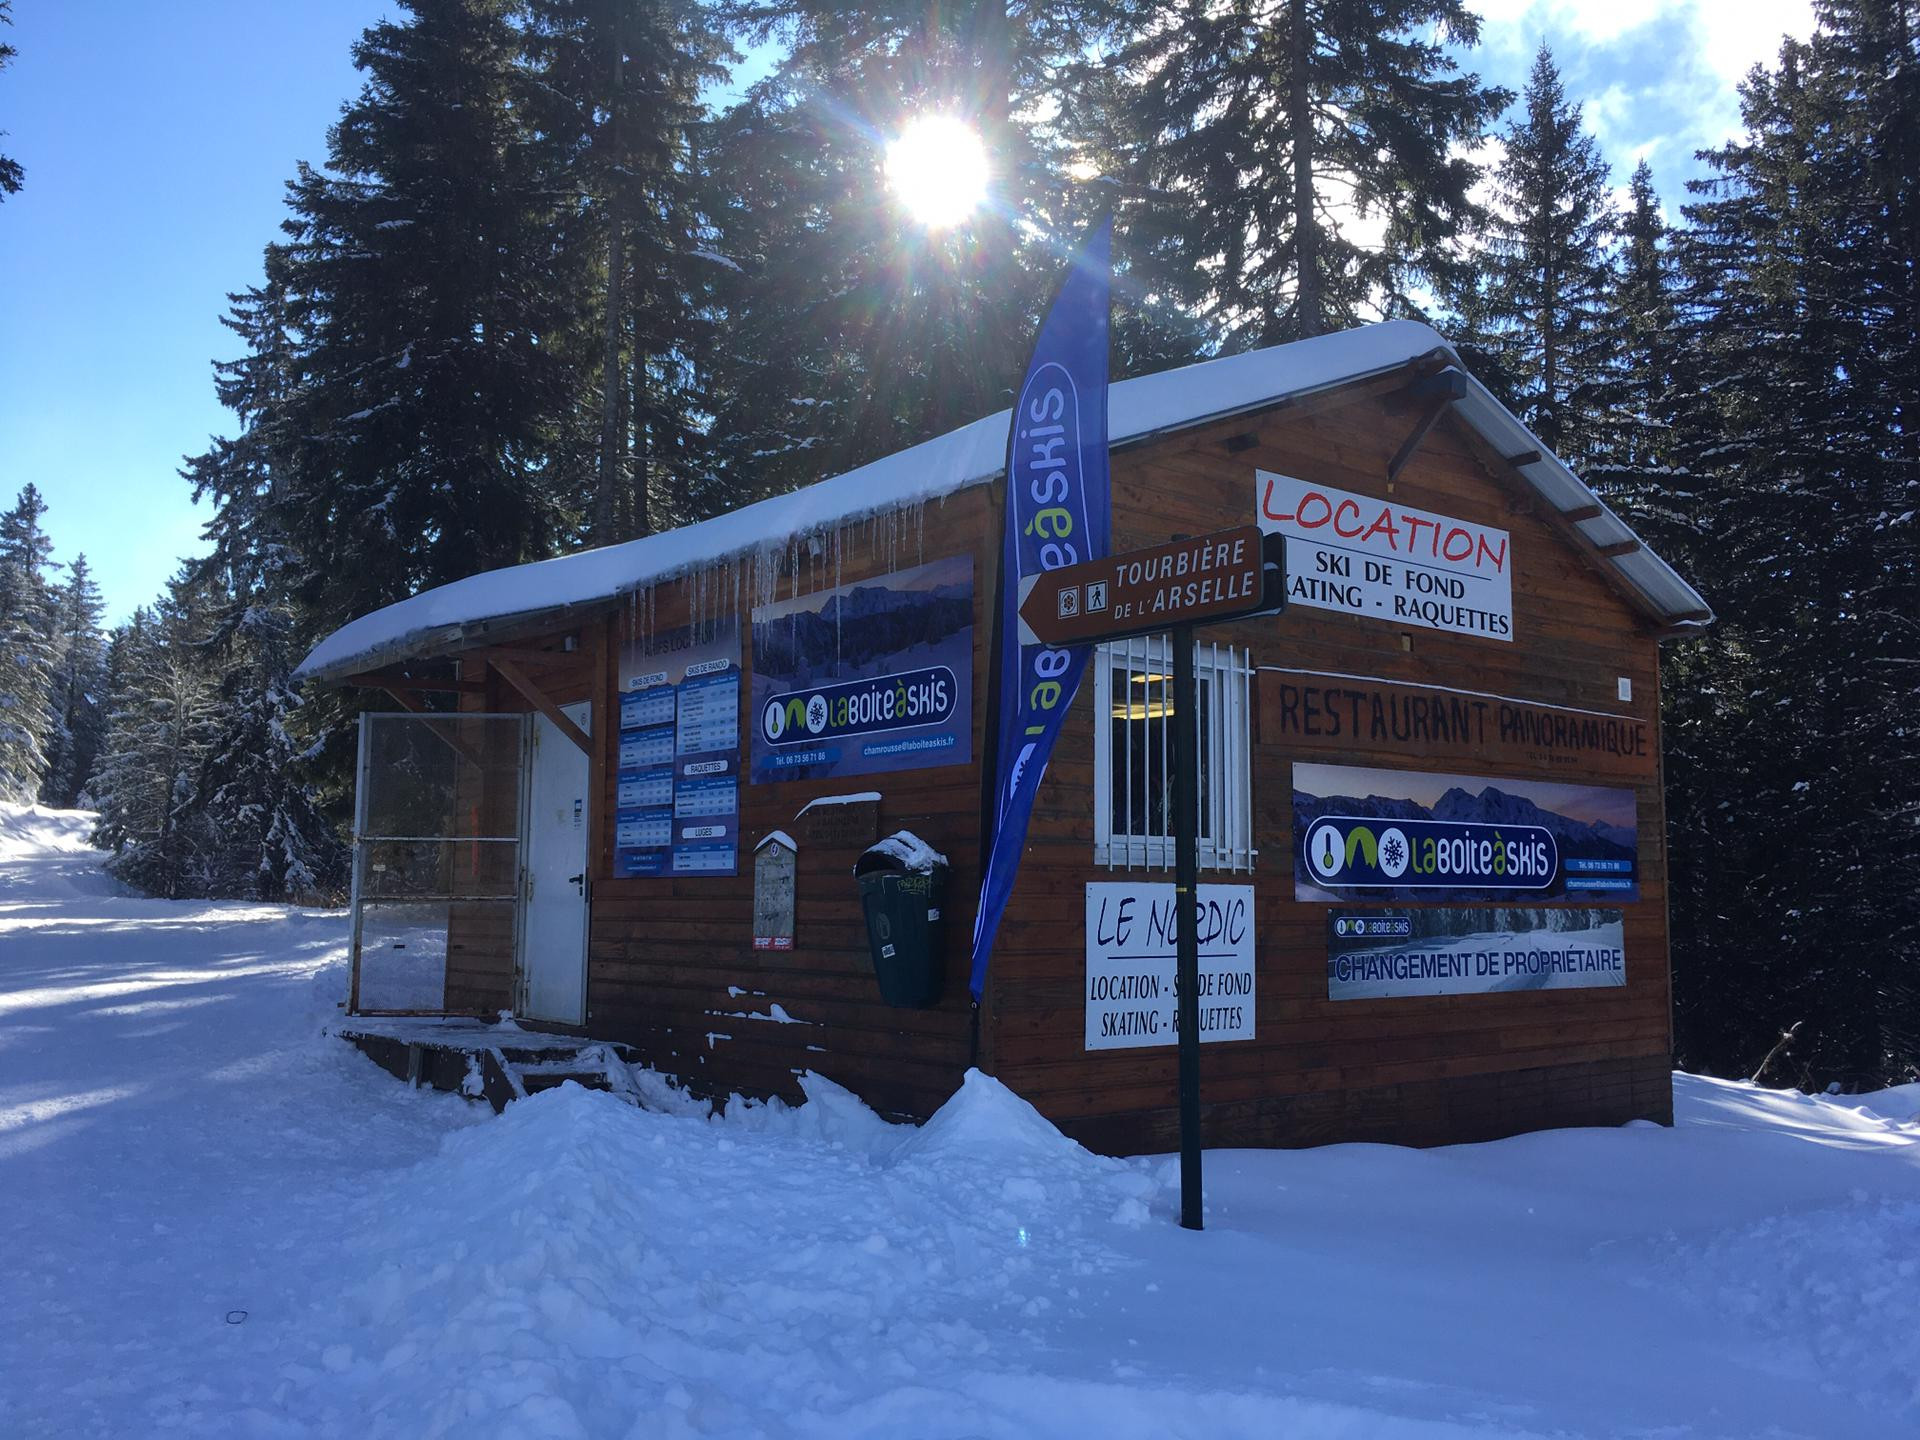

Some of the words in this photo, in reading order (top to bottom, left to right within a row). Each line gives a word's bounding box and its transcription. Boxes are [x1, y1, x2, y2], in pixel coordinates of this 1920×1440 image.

[1263, 479, 1506, 573] LOCATION
[1116, 539, 1245, 588] TOURBIÈRE
[1315, 550, 1351, 578] SKI
[1364, 560, 1393, 586] DE
[1405, 569, 1465, 600] FOND
[1114, 602, 1132, 620] DE
[1138, 571, 1254, 616] L'ARSELLE
[1393, 594, 1510, 635] RAQUETTES
[1280, 684, 1489, 744] RESTAURANT
[1500, 704, 1648, 757] PANORAMIQUE
[786, 754, 794, 765] 06
[864, 736, 955, 756] chamrousse@laboiteaskis.fr
[690, 762, 721, 773] RAQUETTES
[695, 827, 713, 837] LUGES
[1097, 897, 1136, 947] LE
[1335, 953, 1472, 982] CHANGEMENT
[1476, 951, 1500, 976] DE
[1504, 944, 1622, 975] PROPRIÉTAIRE
[1091, 974, 1160, 1001] LOCATION
[1198, 973, 1213, 997] DE
[1217, 972, 1252, 996] FOND
[1101, 1010, 1159, 1037] SKATING
[1172, 1007, 1243, 1033] RUETTES
